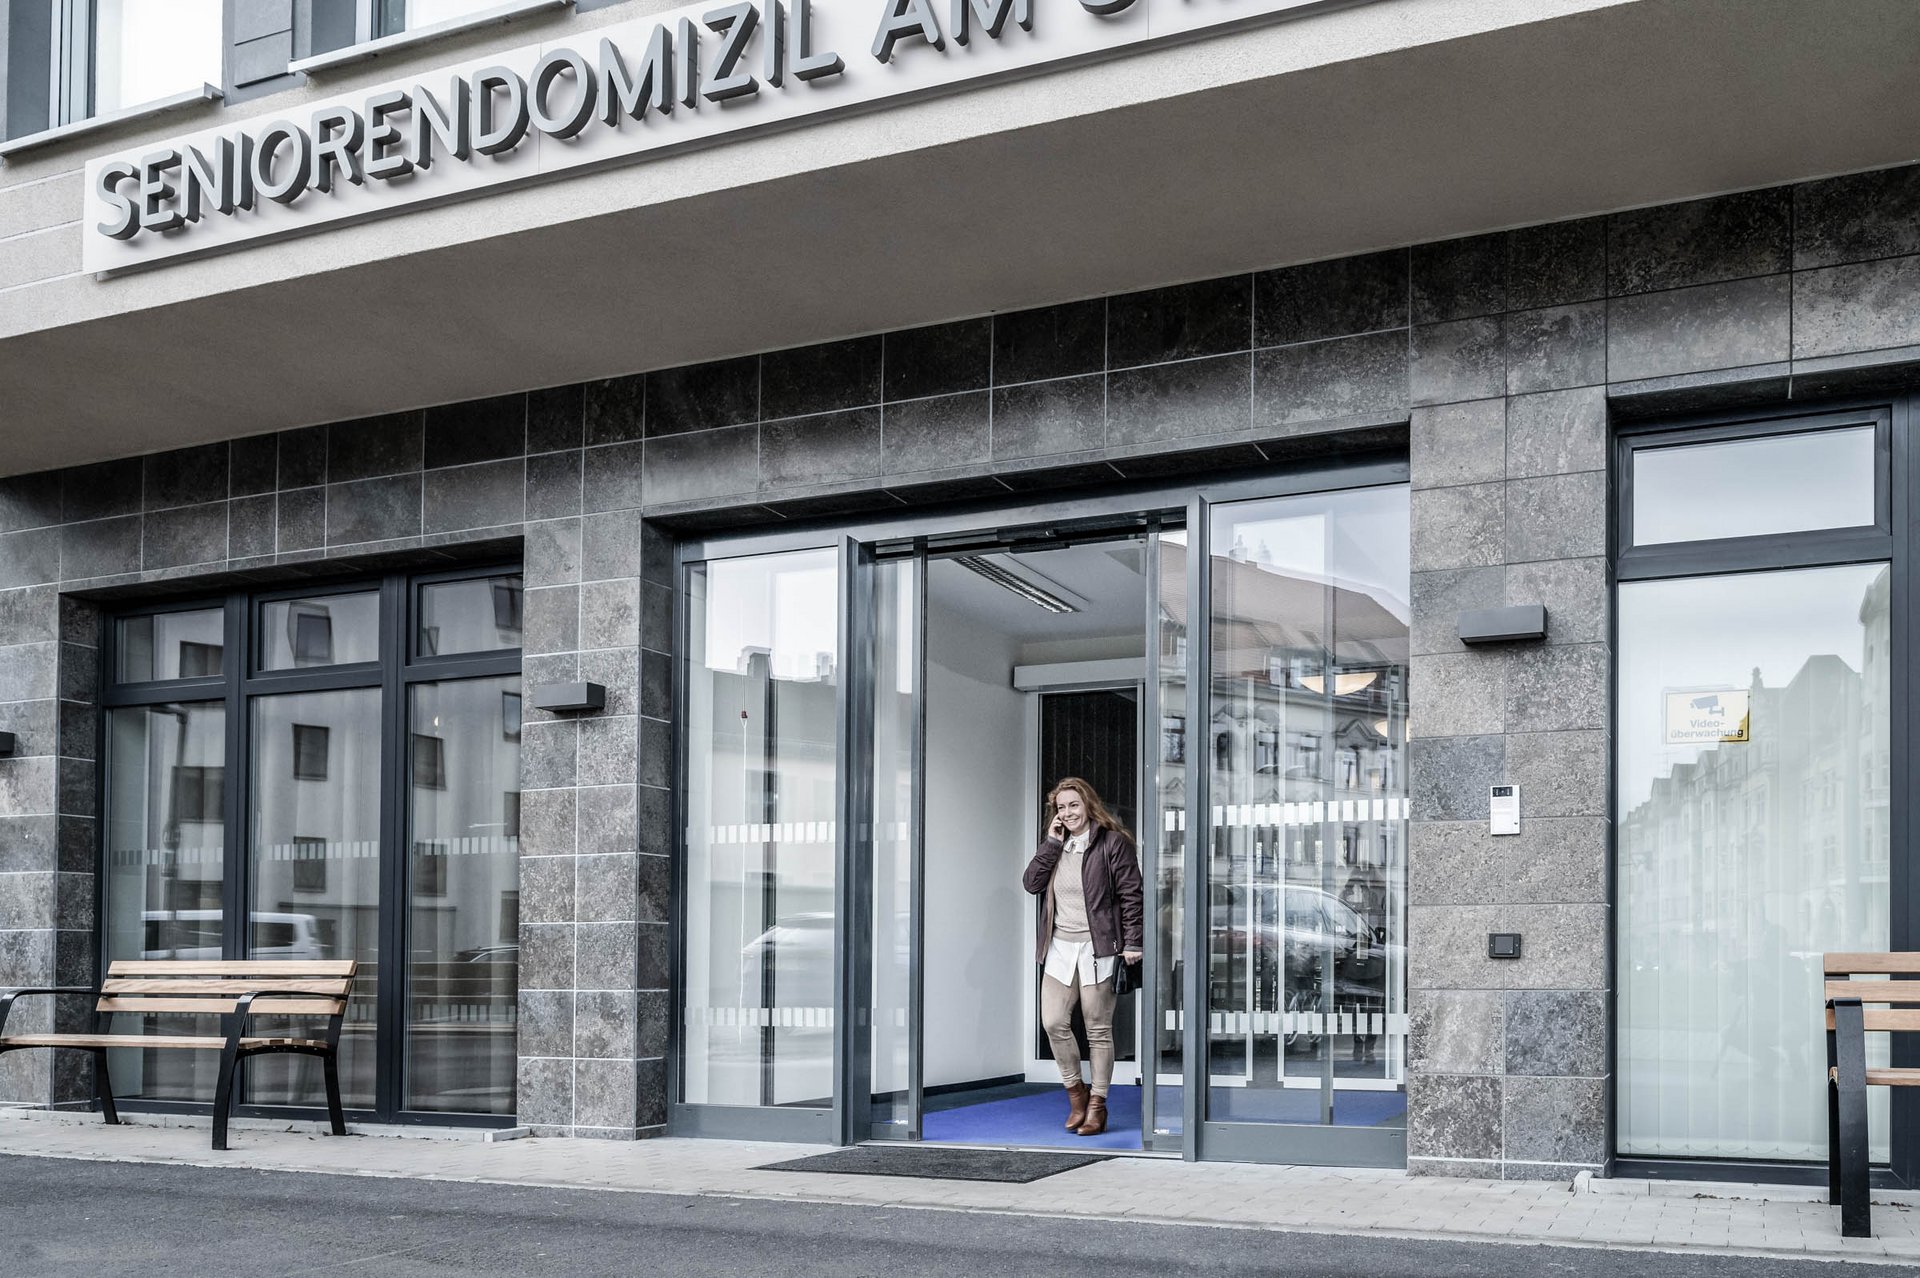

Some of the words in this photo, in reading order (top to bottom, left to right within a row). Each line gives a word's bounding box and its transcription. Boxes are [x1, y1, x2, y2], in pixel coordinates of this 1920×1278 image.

[96, 0, 845, 239] SENIORENDOMIZIL
[1690, 719, 1725, 728] Video-
[1670, 729, 1744, 738] überwachung
